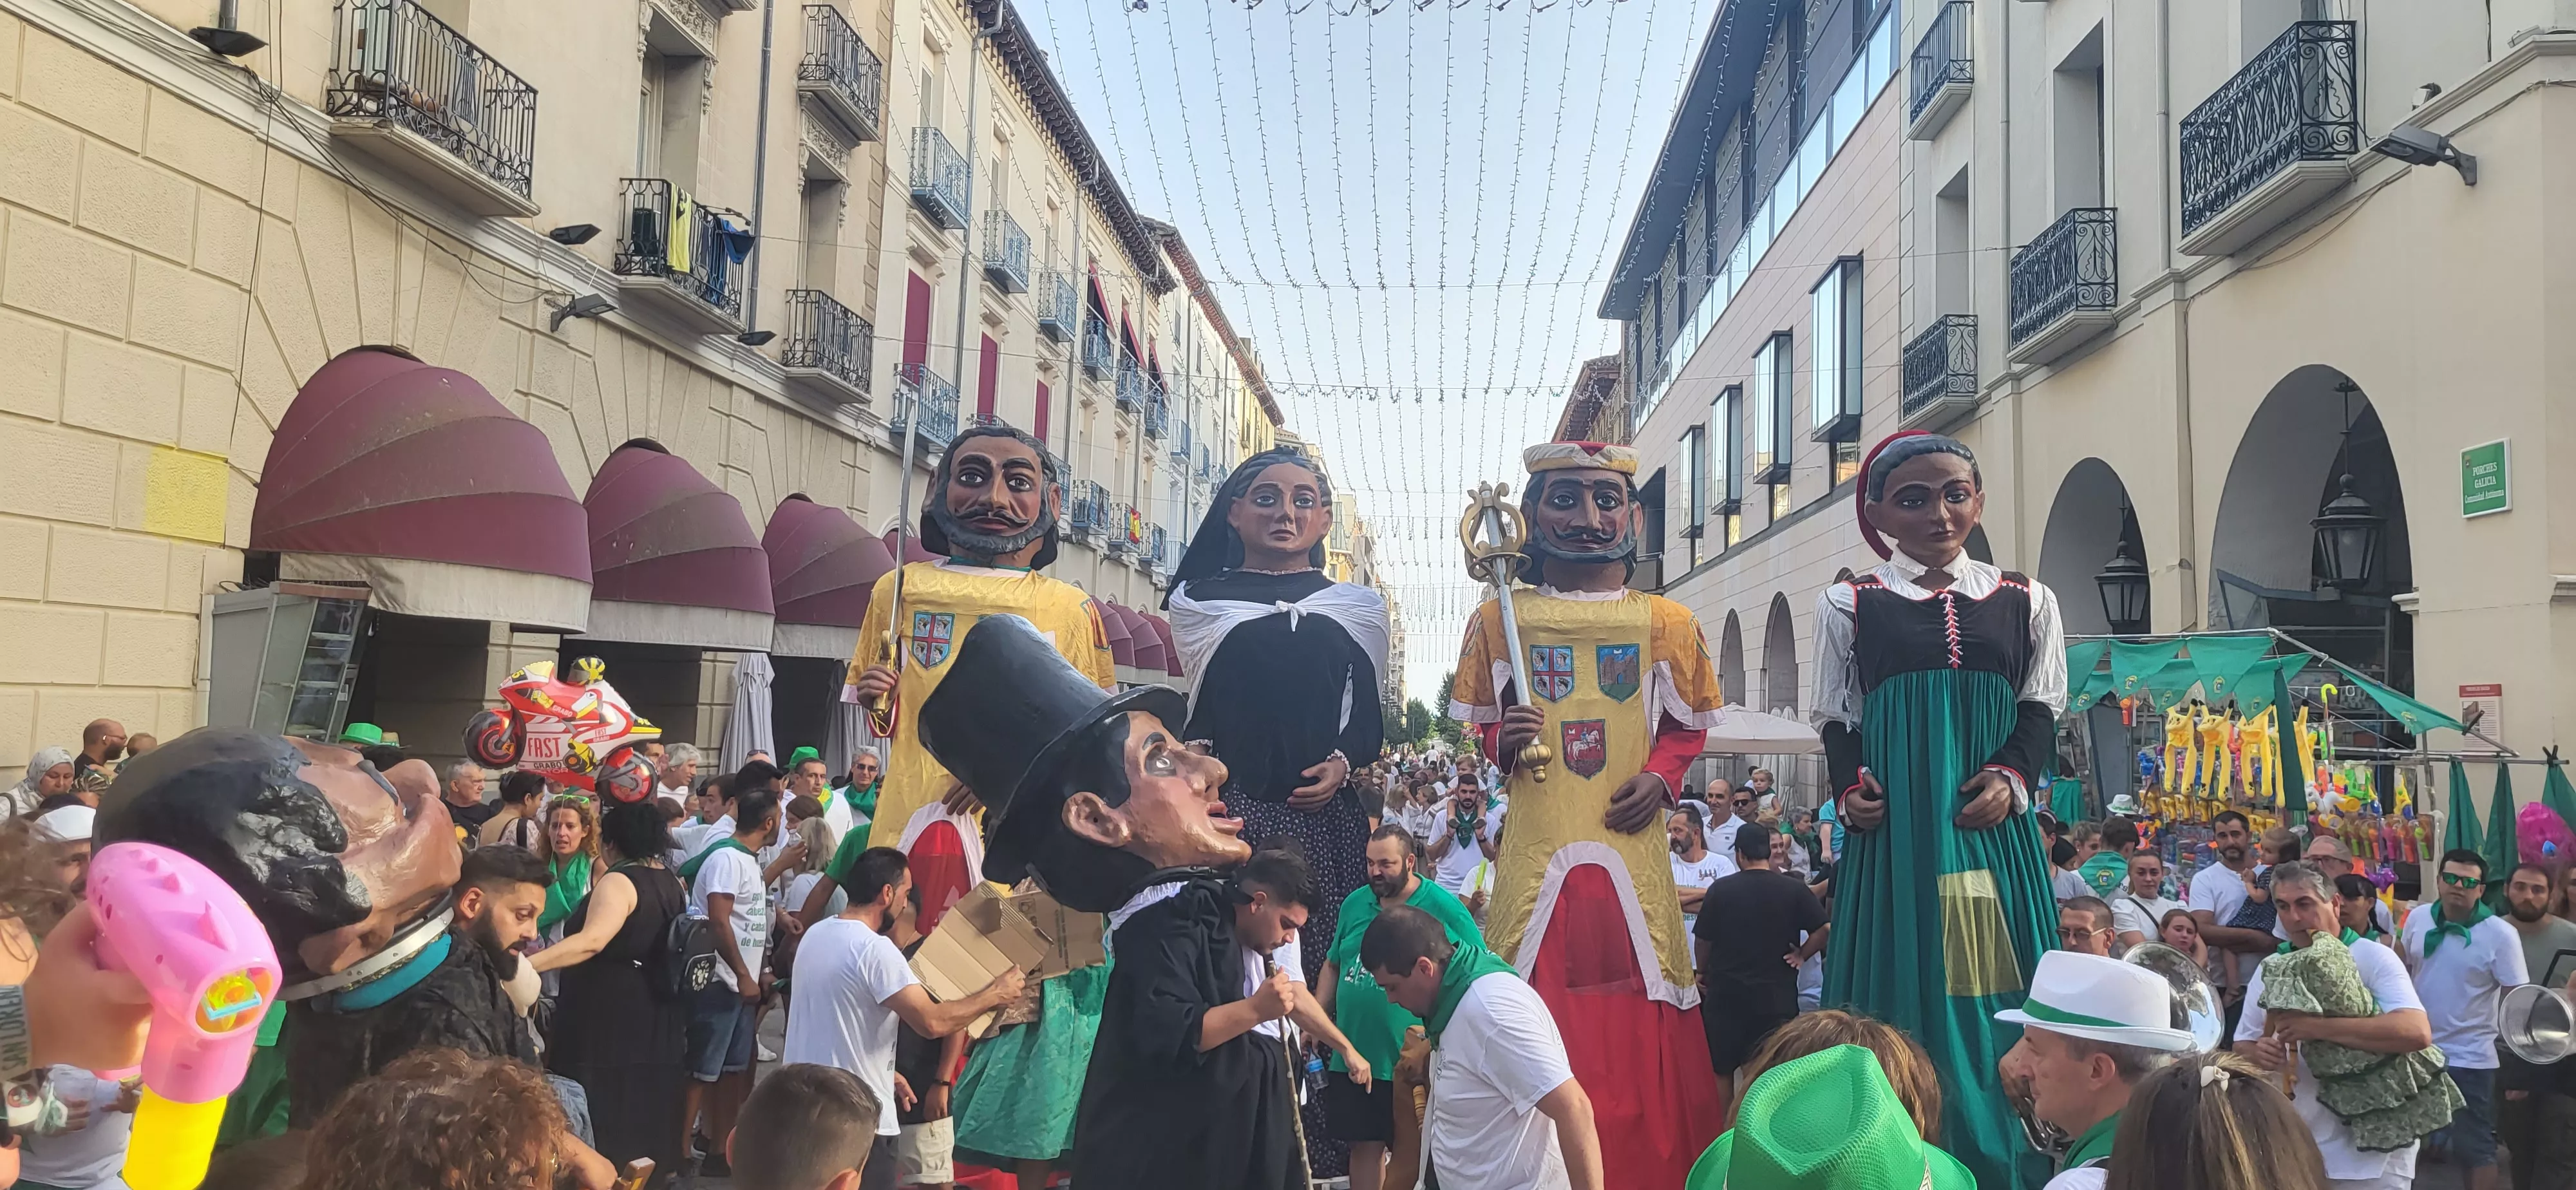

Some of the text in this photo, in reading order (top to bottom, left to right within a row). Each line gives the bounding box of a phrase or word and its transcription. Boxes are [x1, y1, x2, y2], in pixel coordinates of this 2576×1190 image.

[2473, 462, 2497, 477] PORCHES
[2474, 475, 2497, 488] GALICIA
[552, 704, 573, 717] GRABO
[527, 737, 562, 758] FAST
[533, 760, 563, 770] GRABO
[741, 936, 752, 947] de
[2, 1041, 28, 1072] SAN
